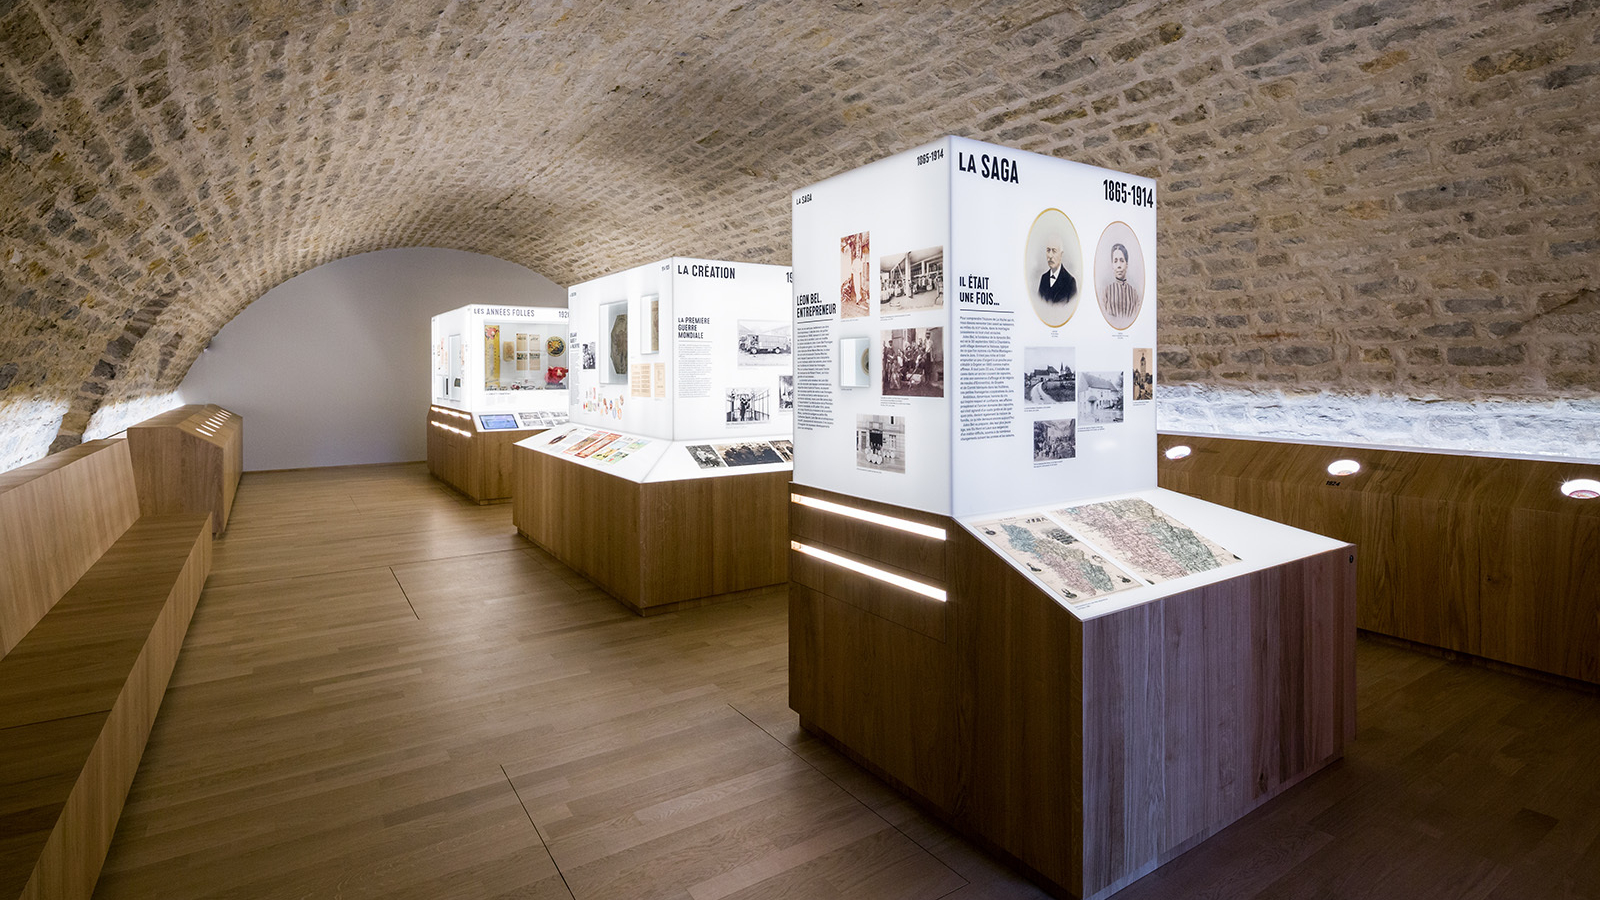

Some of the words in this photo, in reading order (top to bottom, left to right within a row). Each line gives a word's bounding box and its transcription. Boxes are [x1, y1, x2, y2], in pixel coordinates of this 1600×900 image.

[916, 148, 944, 166] 1865-1914
[959, 152, 977, 174] LA
[981, 154, 1019, 184] SAGA
[796, 198, 801, 206] LA
[801, 193, 813, 204] SAGA
[1103, 179, 1154, 209] 1865-1914
[677, 264, 689, 275] LA
[691, 263, 736, 280] CRÉATION
[959, 276, 967, 287] IL
[968, 273, 990, 290] ÉTAIT
[959, 291, 974, 303] UNE
[473, 307, 485, 315] LES
[512, 308, 535, 318] FOLLES
[796, 303, 837, 319] ENTREPRENEUR
[677, 323, 698, 332] GUERRE
[677, 331, 704, 340] MONDIALE
